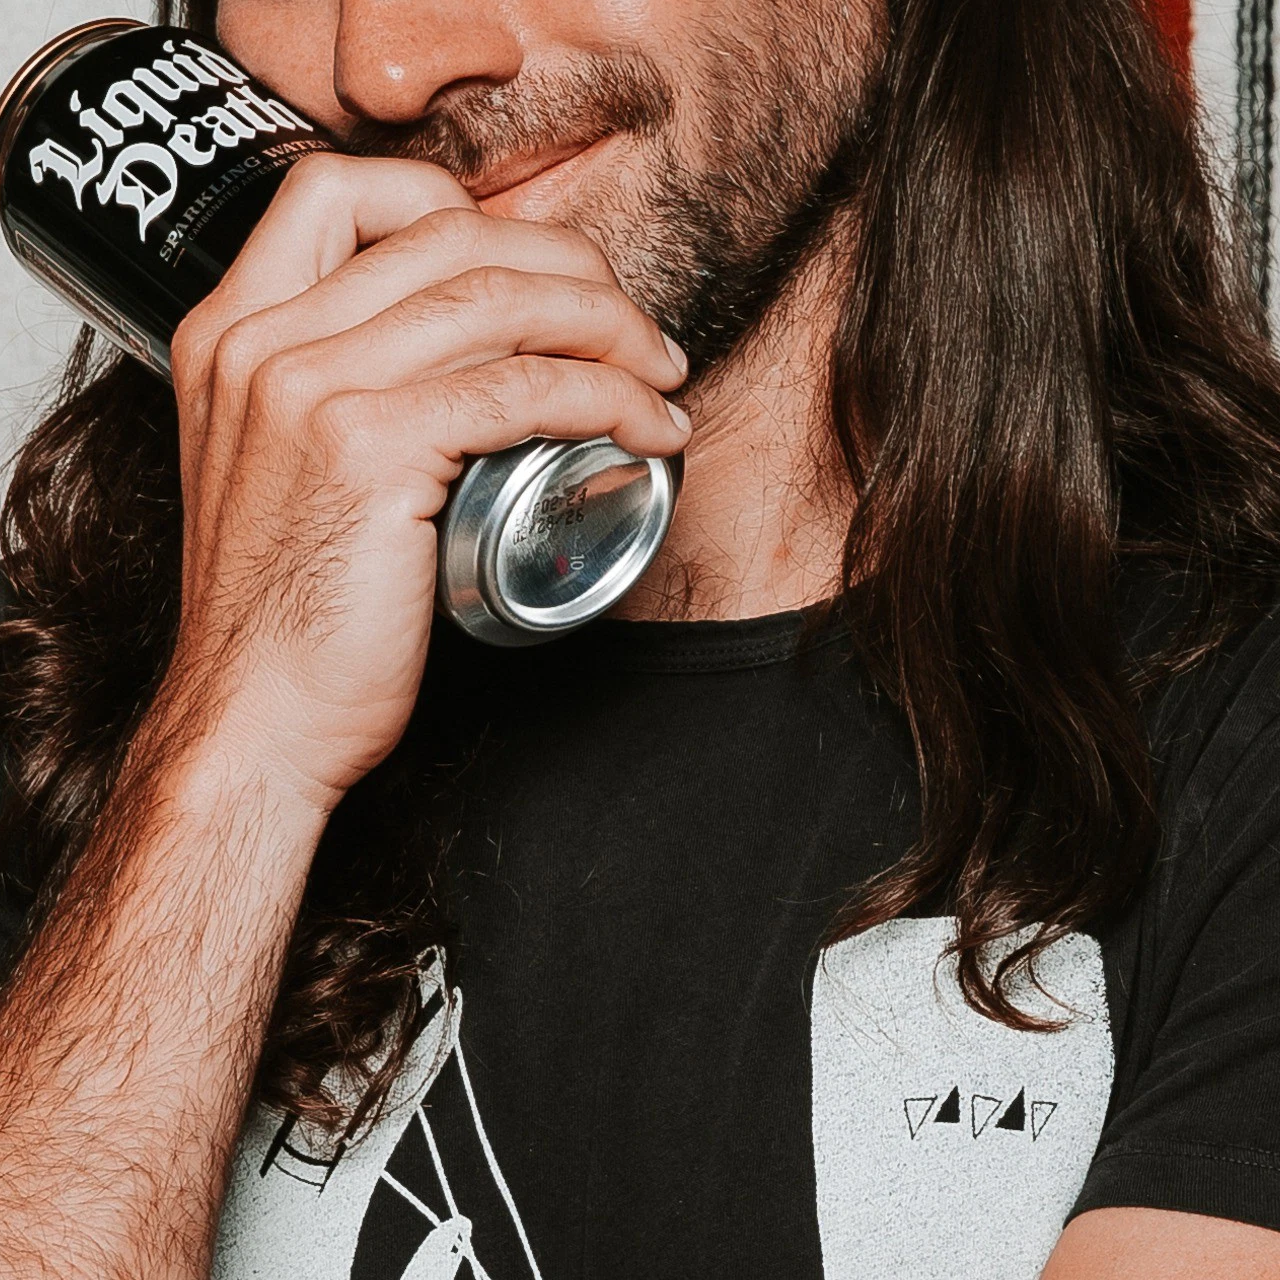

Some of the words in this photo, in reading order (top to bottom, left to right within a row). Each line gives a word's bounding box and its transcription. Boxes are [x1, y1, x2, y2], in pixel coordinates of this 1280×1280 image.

[29, 39, 249, 212] Liquid
[96, 84, 313, 244] Death
[159, 156, 261, 263] SPARKLING
[187, 185, 240, 241] CARBONATED
[570, 553, 585, 571] 10
